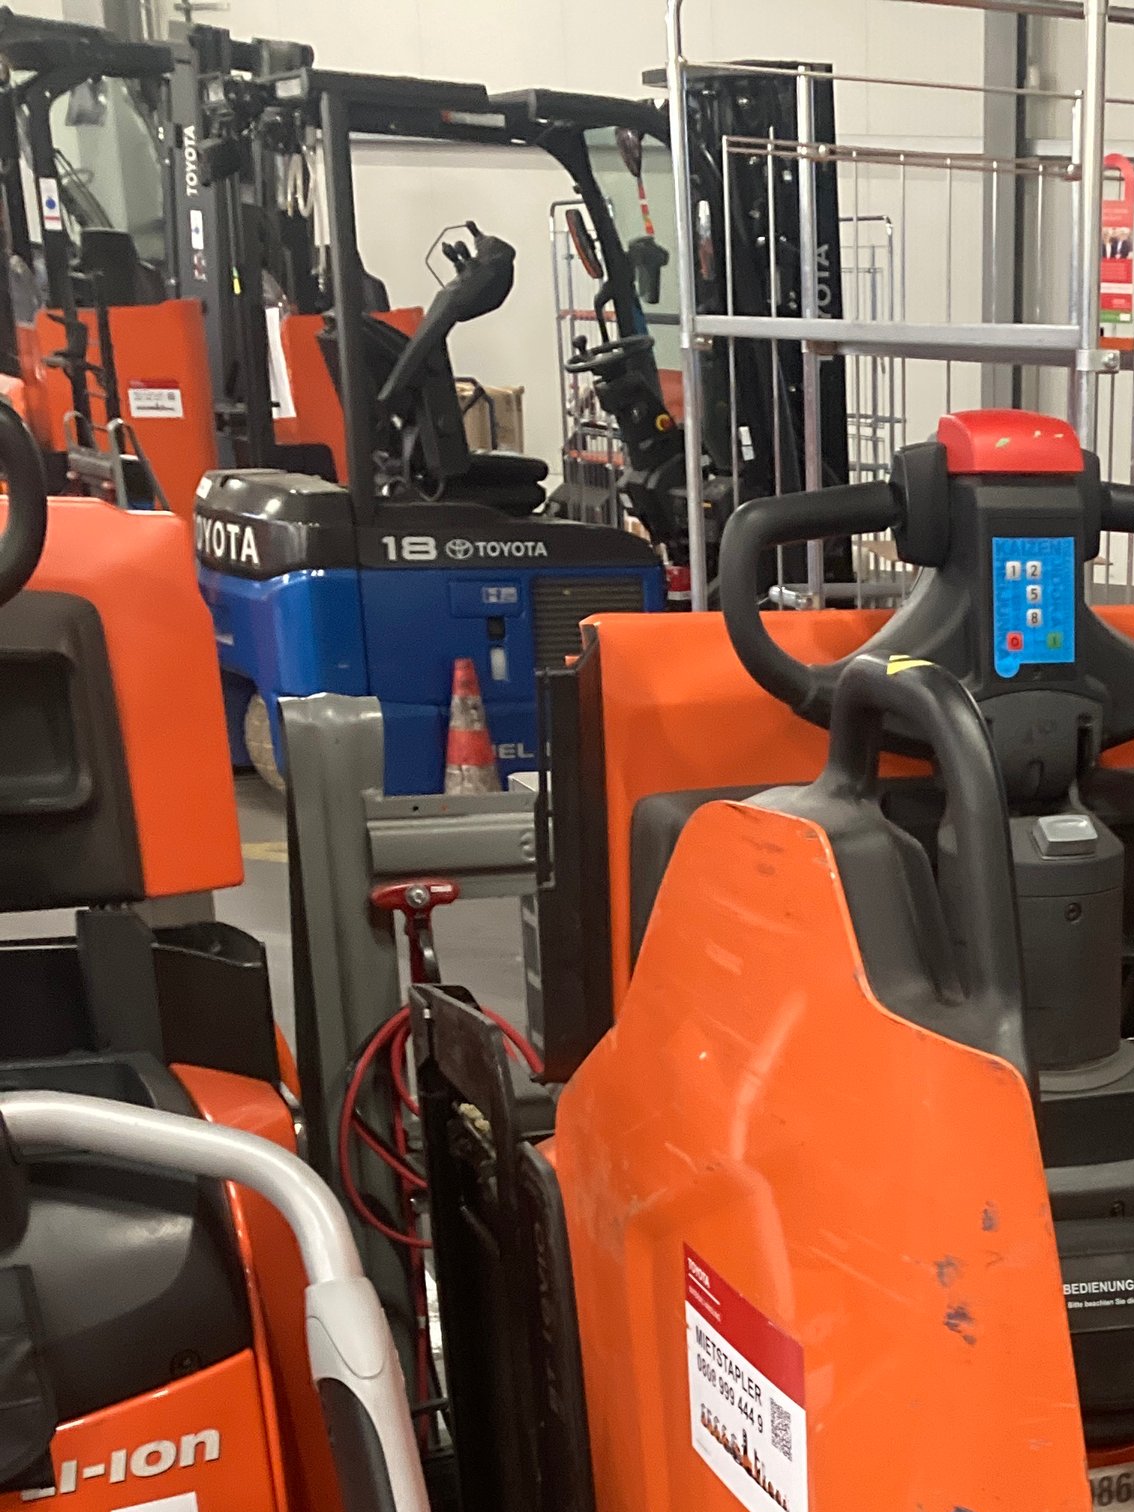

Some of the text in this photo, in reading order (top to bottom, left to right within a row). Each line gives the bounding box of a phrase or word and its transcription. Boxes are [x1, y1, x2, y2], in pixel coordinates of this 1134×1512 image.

[183, 125, 198, 196] TOYOTA
[381, 535, 548, 561] 18 TOYOTA
[1067, 1301, 1083, 1309] Bitte
[1115, 1297, 1126, 1305] Sie
[695, 1325, 762, 1406] MIETSTAPLER
[718, 1376, 735, 1406] 999
[737, 1396, 755, 1427] 444
[757, 1414, 764, 1434] 9
